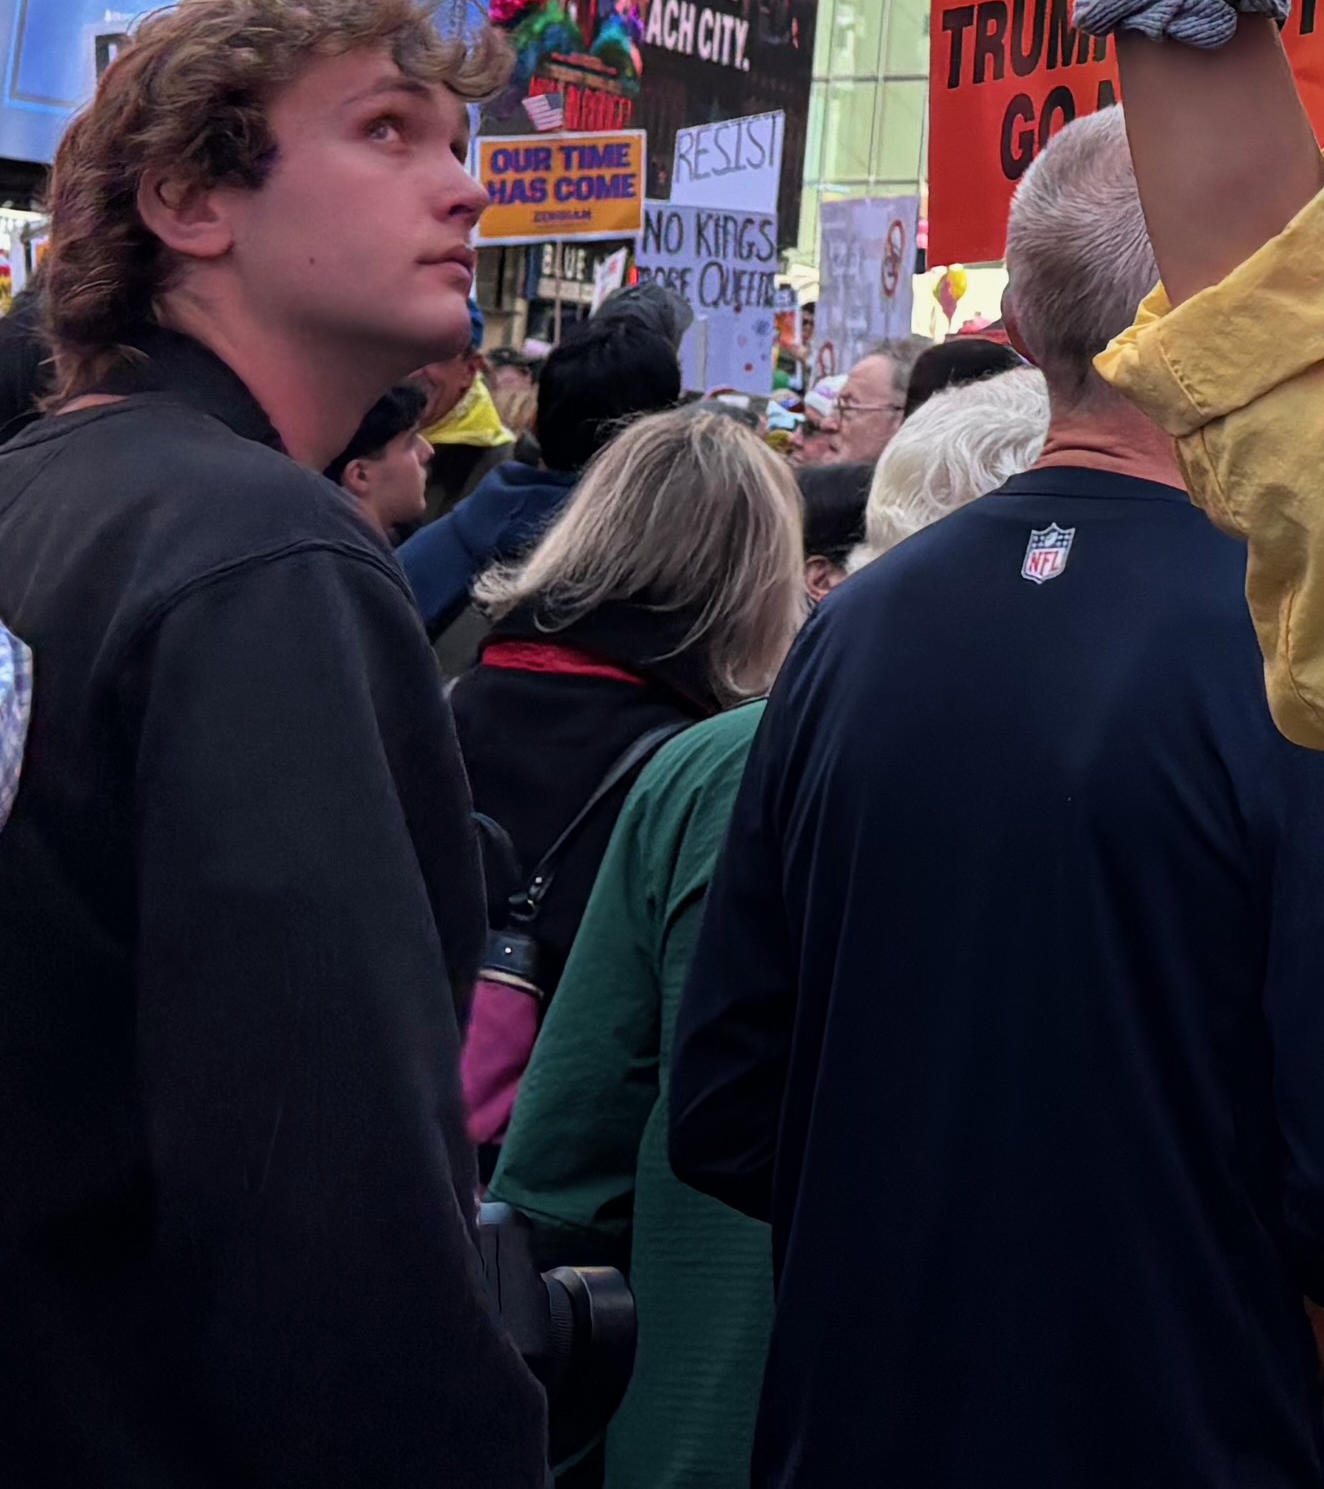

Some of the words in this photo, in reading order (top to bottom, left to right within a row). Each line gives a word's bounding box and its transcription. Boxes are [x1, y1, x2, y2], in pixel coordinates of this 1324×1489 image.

[697, 12, 750, 73] CITY.
[490, 146, 553, 175] OUR
[560, 142, 631, 171] TIME
[675, 114, 778, 185] RESIST
[486, 176, 549, 205] HAS
[553, 173, 636, 203] COME
[641, 210, 685, 256] NO
[1029, 550, 1060, 576] NFL
